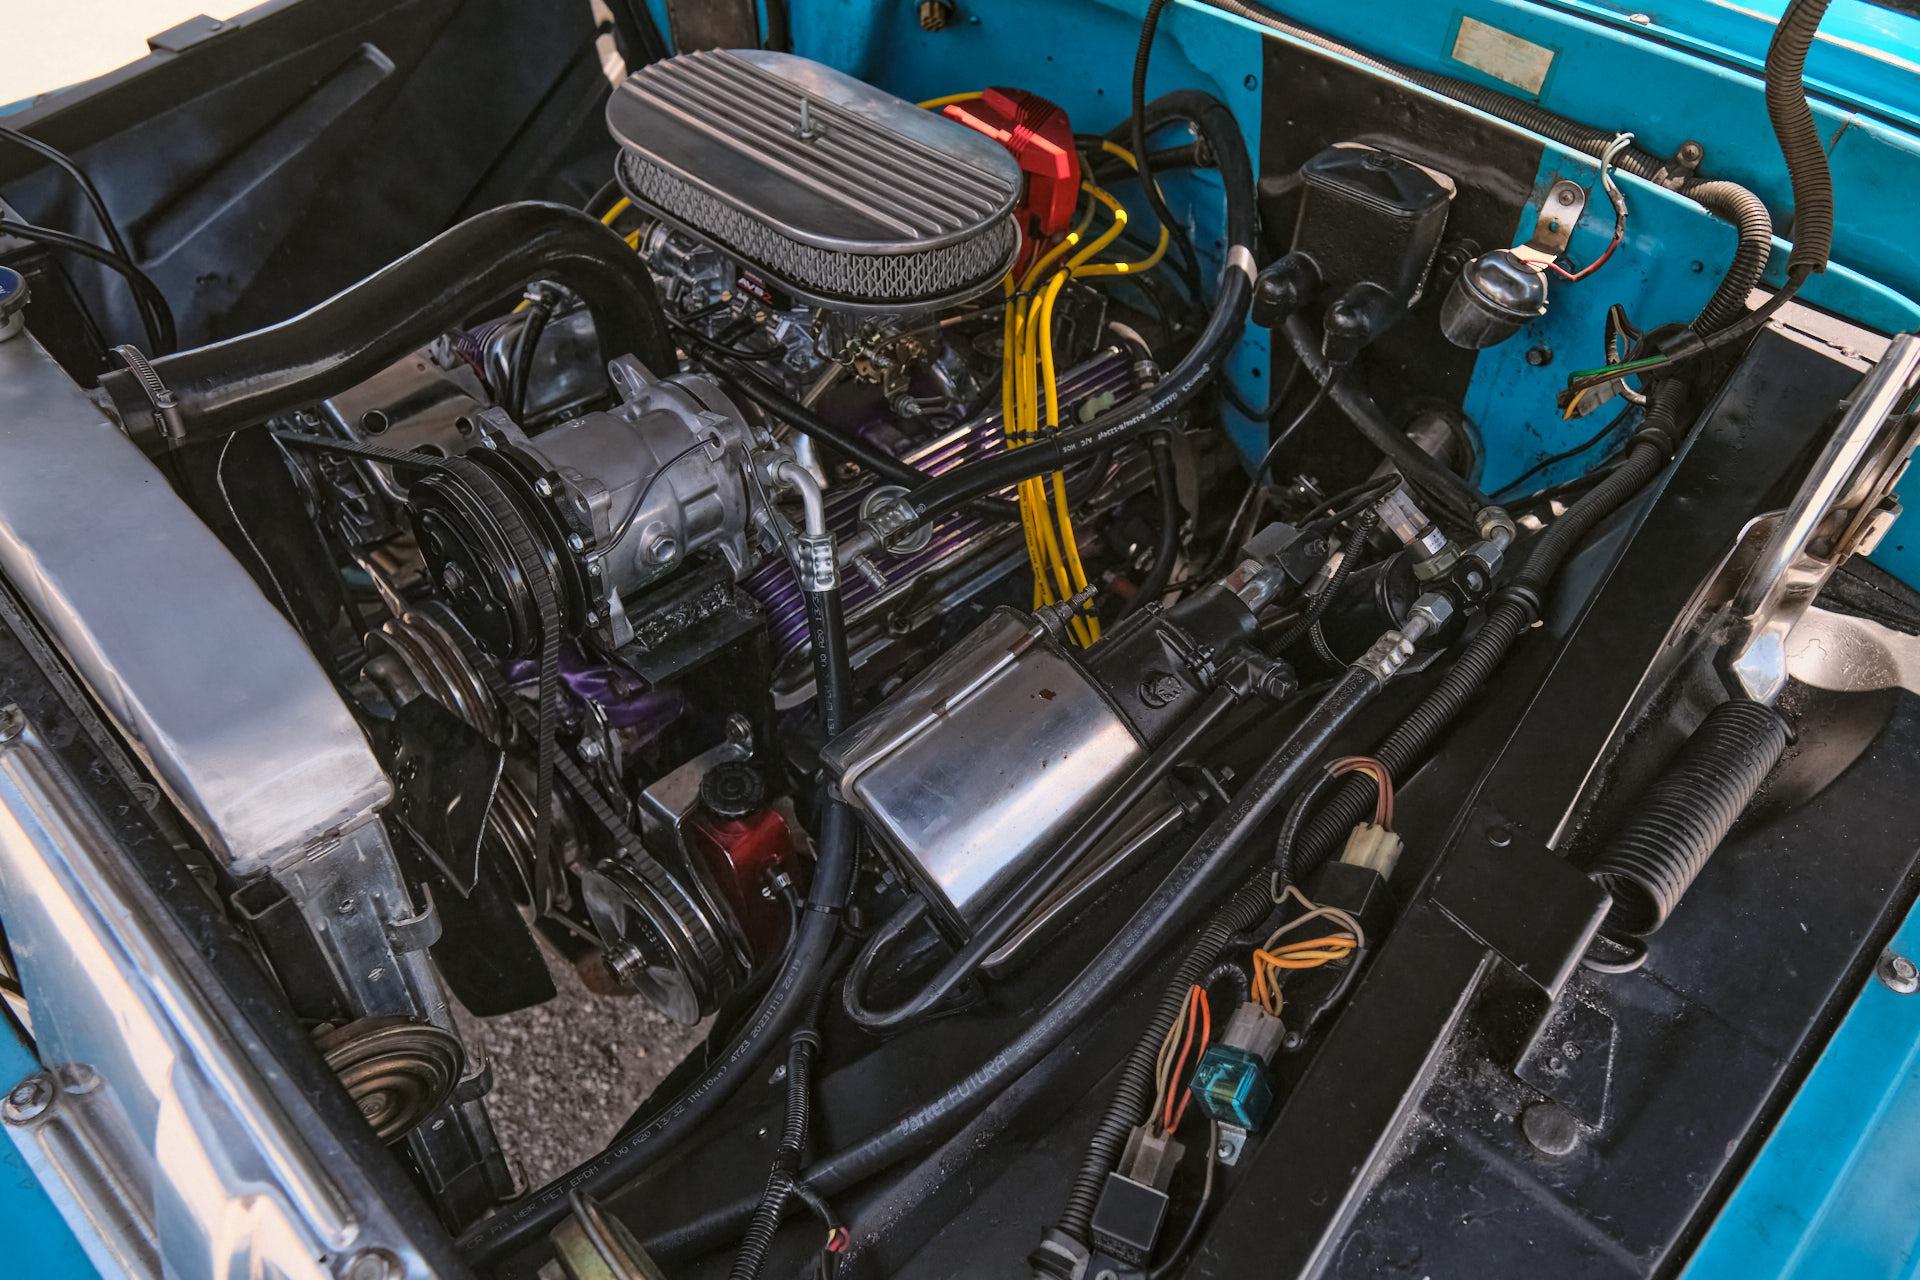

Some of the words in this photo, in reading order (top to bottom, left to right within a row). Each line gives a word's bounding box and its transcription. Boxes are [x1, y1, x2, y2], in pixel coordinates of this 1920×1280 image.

[1149, 391, 1179, 414] GALAXY
[1080, 436, 1092, 446] A/C
[569, 1164, 599, 1187] EPDM
[727, 1037, 752, 1063] 4723
[748, 992, 785, 1038] 20231115
[895, 1093, 950, 1139] Parker
[945, 1054, 1008, 1103] FUTURA
